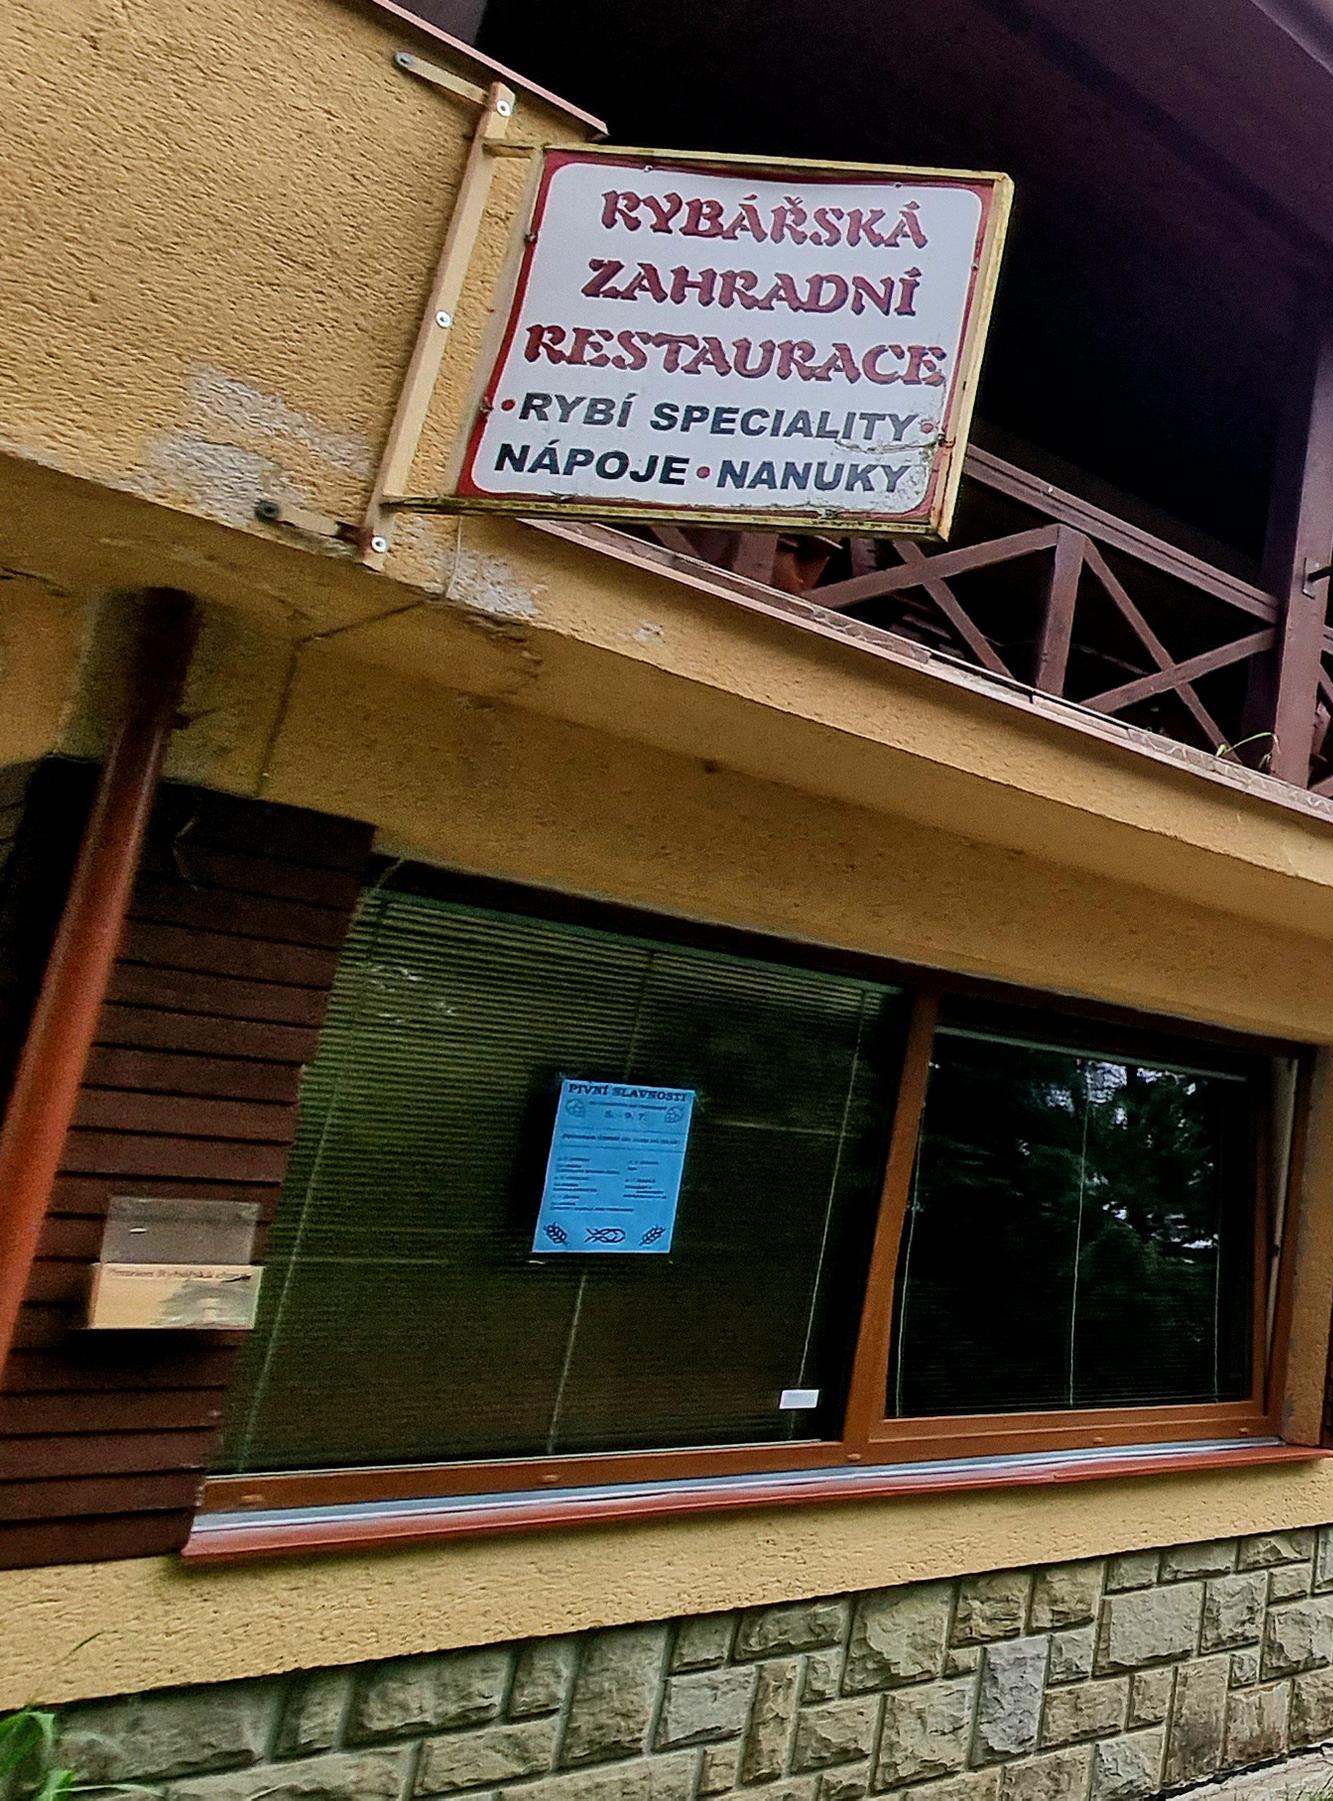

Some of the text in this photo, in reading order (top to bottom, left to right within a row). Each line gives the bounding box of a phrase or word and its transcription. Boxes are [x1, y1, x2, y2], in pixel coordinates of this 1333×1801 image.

[600, 189, 928, 249] RYBÁŘSKÁ
[581, 258, 921, 318] ZAHRADNÍ
[523, 323, 948, 387] RESTAURACE
[519, 391, 920, 443] RYBÍ SPECIALITY
[493, 438, 909, 494] NÁPOJE NANUKY
[568, 1083, 688, 1102] PIVNÍ SLAVNOSTI
